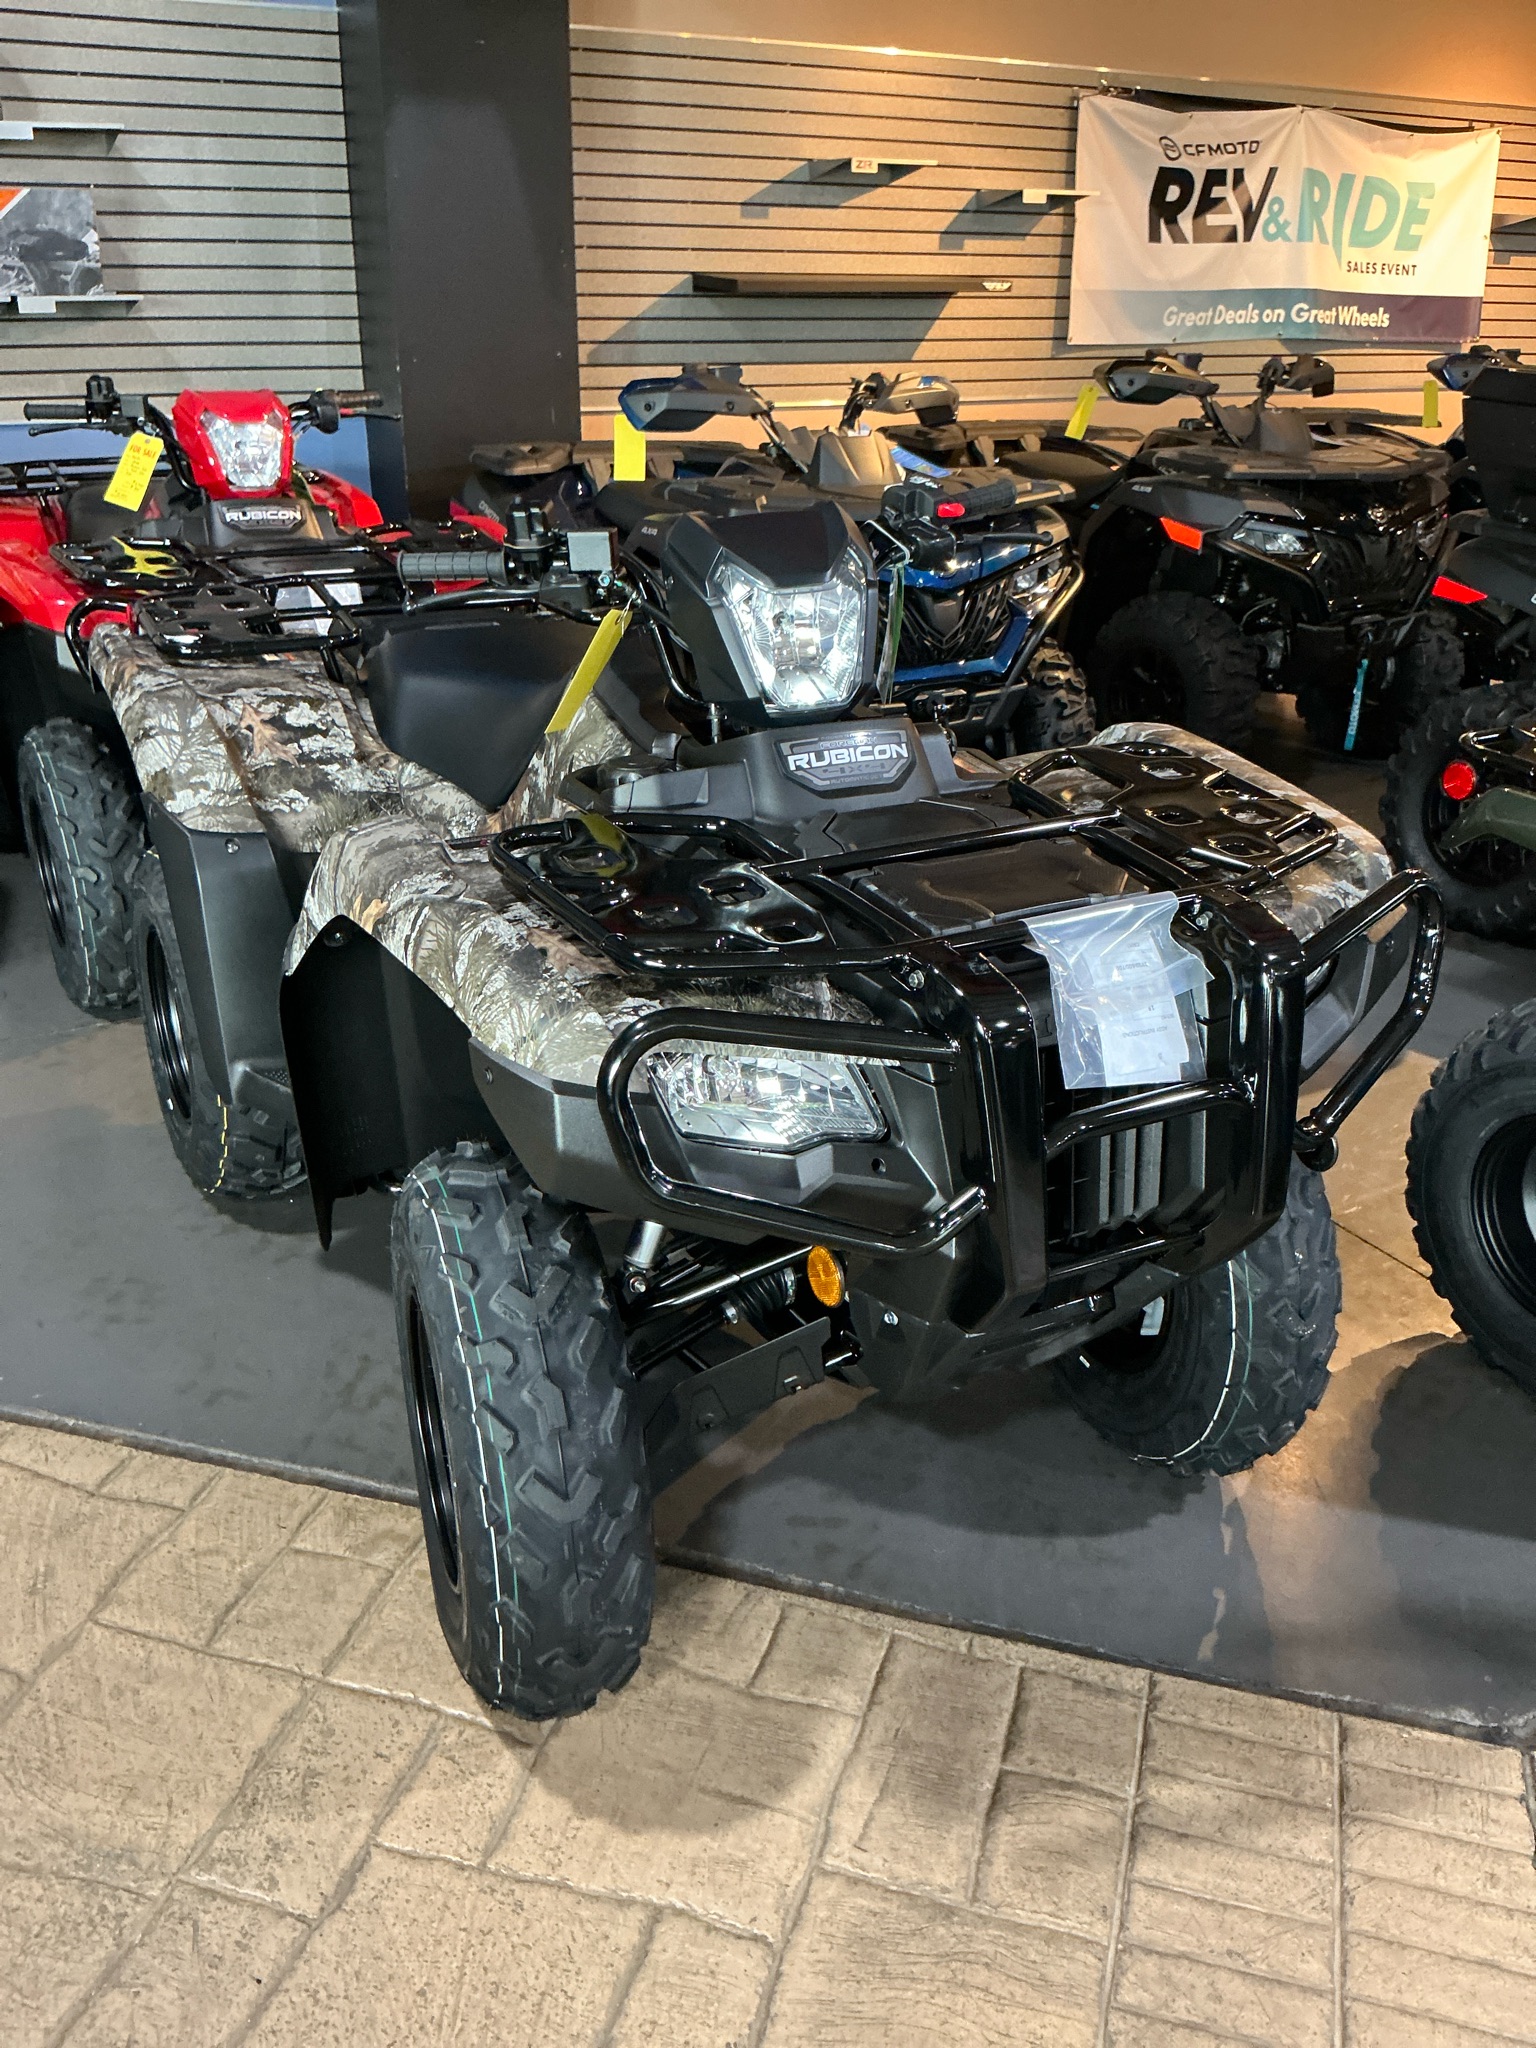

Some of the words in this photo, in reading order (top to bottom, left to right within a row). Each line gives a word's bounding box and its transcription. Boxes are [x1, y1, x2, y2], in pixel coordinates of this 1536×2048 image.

[1183, 140, 1261, 157] CFMOTO
[1346, 260, 1378, 275] SALES
[1380, 262, 1418, 276] EVENT
[1162, 305, 1214, 327] Great
[1214, 303, 1260, 325] Deals
[1262, 307, 1286, 323] on
[1290, 302, 1338, 324] Great
[1338, 305, 1390, 328] Wheels
[129, 444, 141, 453] FOR
[225, 510, 302, 522] RUBICON
[787, 743, 909, 771] RUBICON
